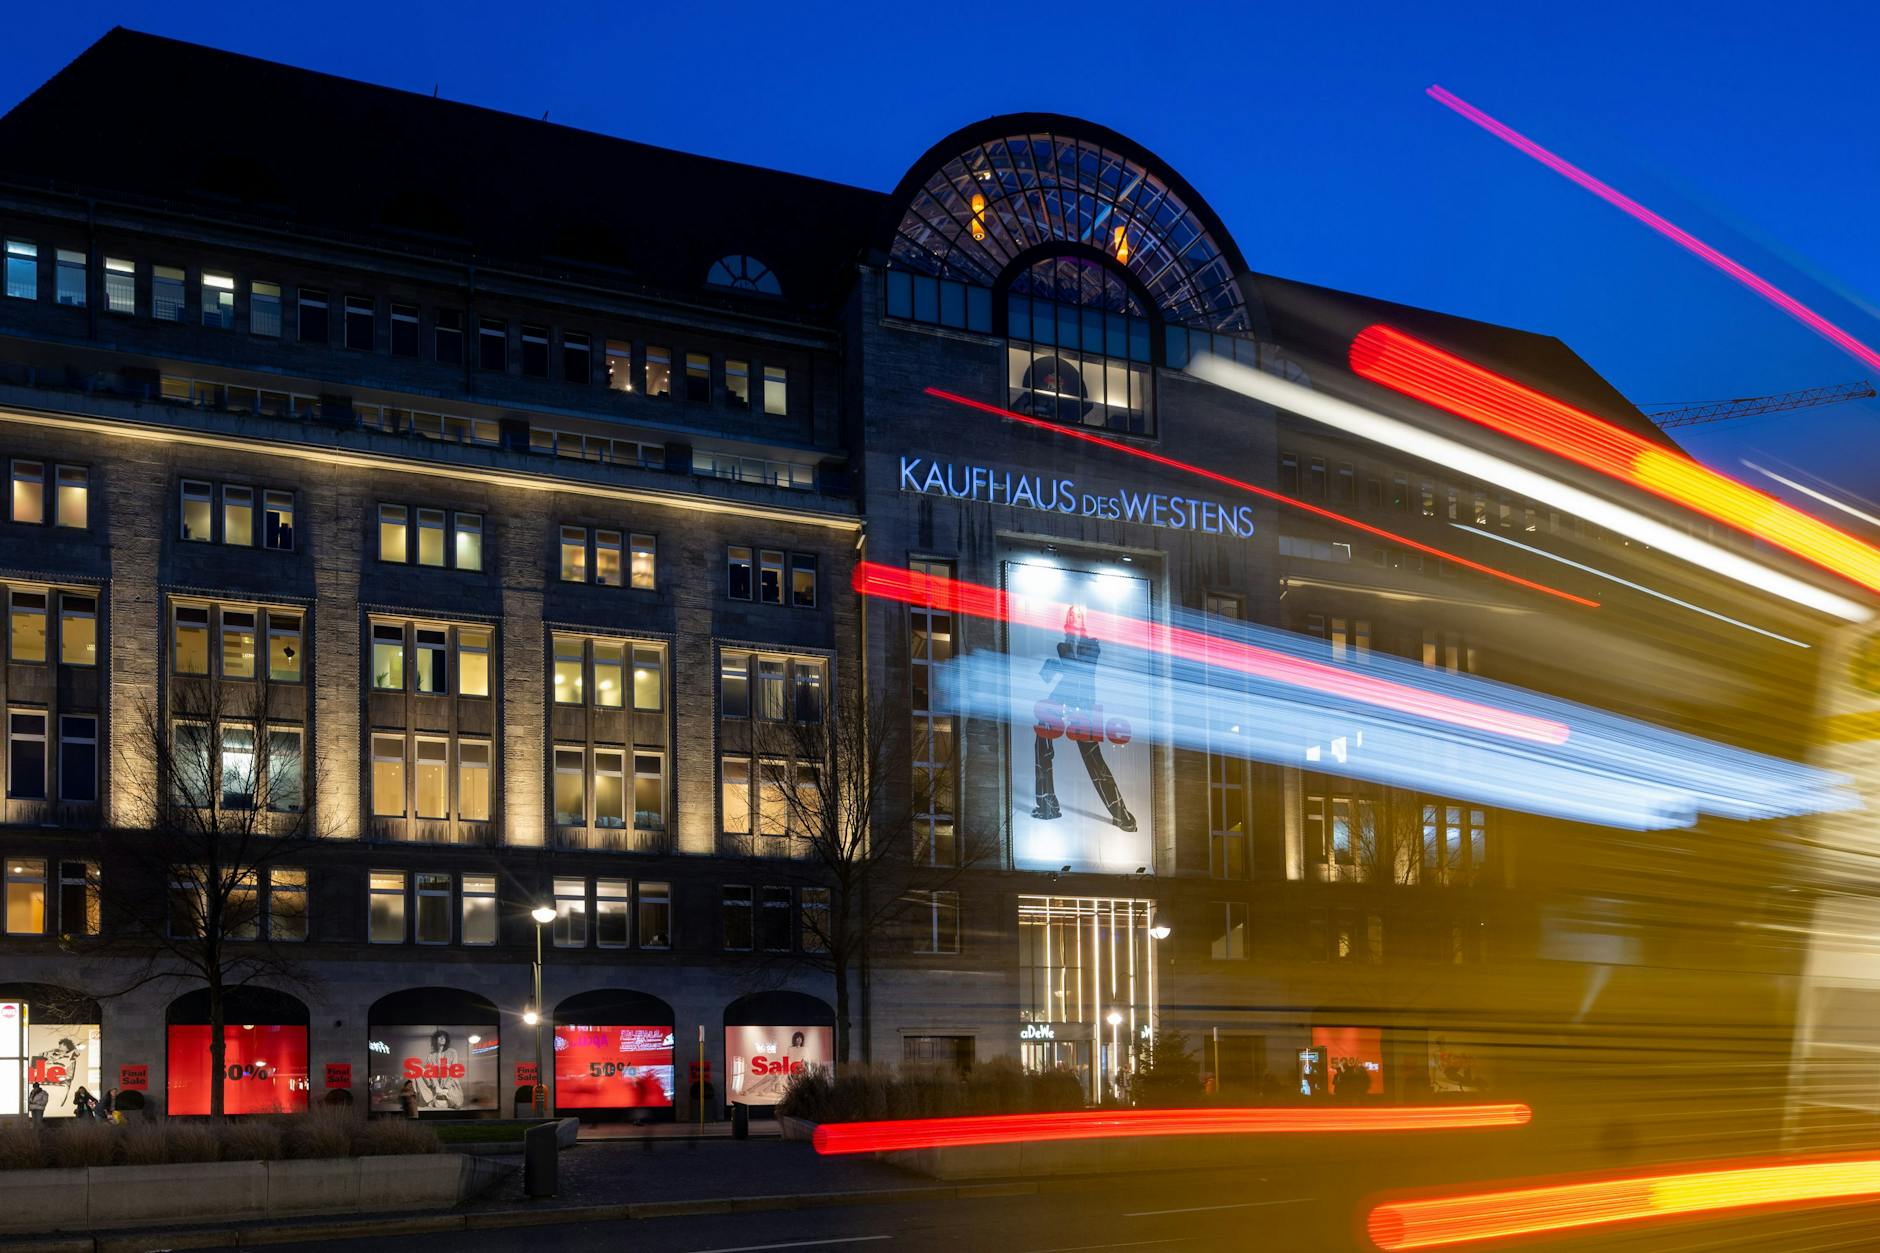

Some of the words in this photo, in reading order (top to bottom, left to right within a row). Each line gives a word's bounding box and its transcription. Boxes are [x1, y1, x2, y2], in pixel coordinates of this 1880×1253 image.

[901, 456, 1077, 514] KAUFHAUS
[1082, 494, 1121, 519] DES
[1120, 489, 1255, 538] WESTENS
[1033, 699, 1132, 745] Sale
[223, 1063, 268, 1081] 0%
[403, 1056, 465, 1079] Sale
[751, 1056, 805, 1076] Sale
